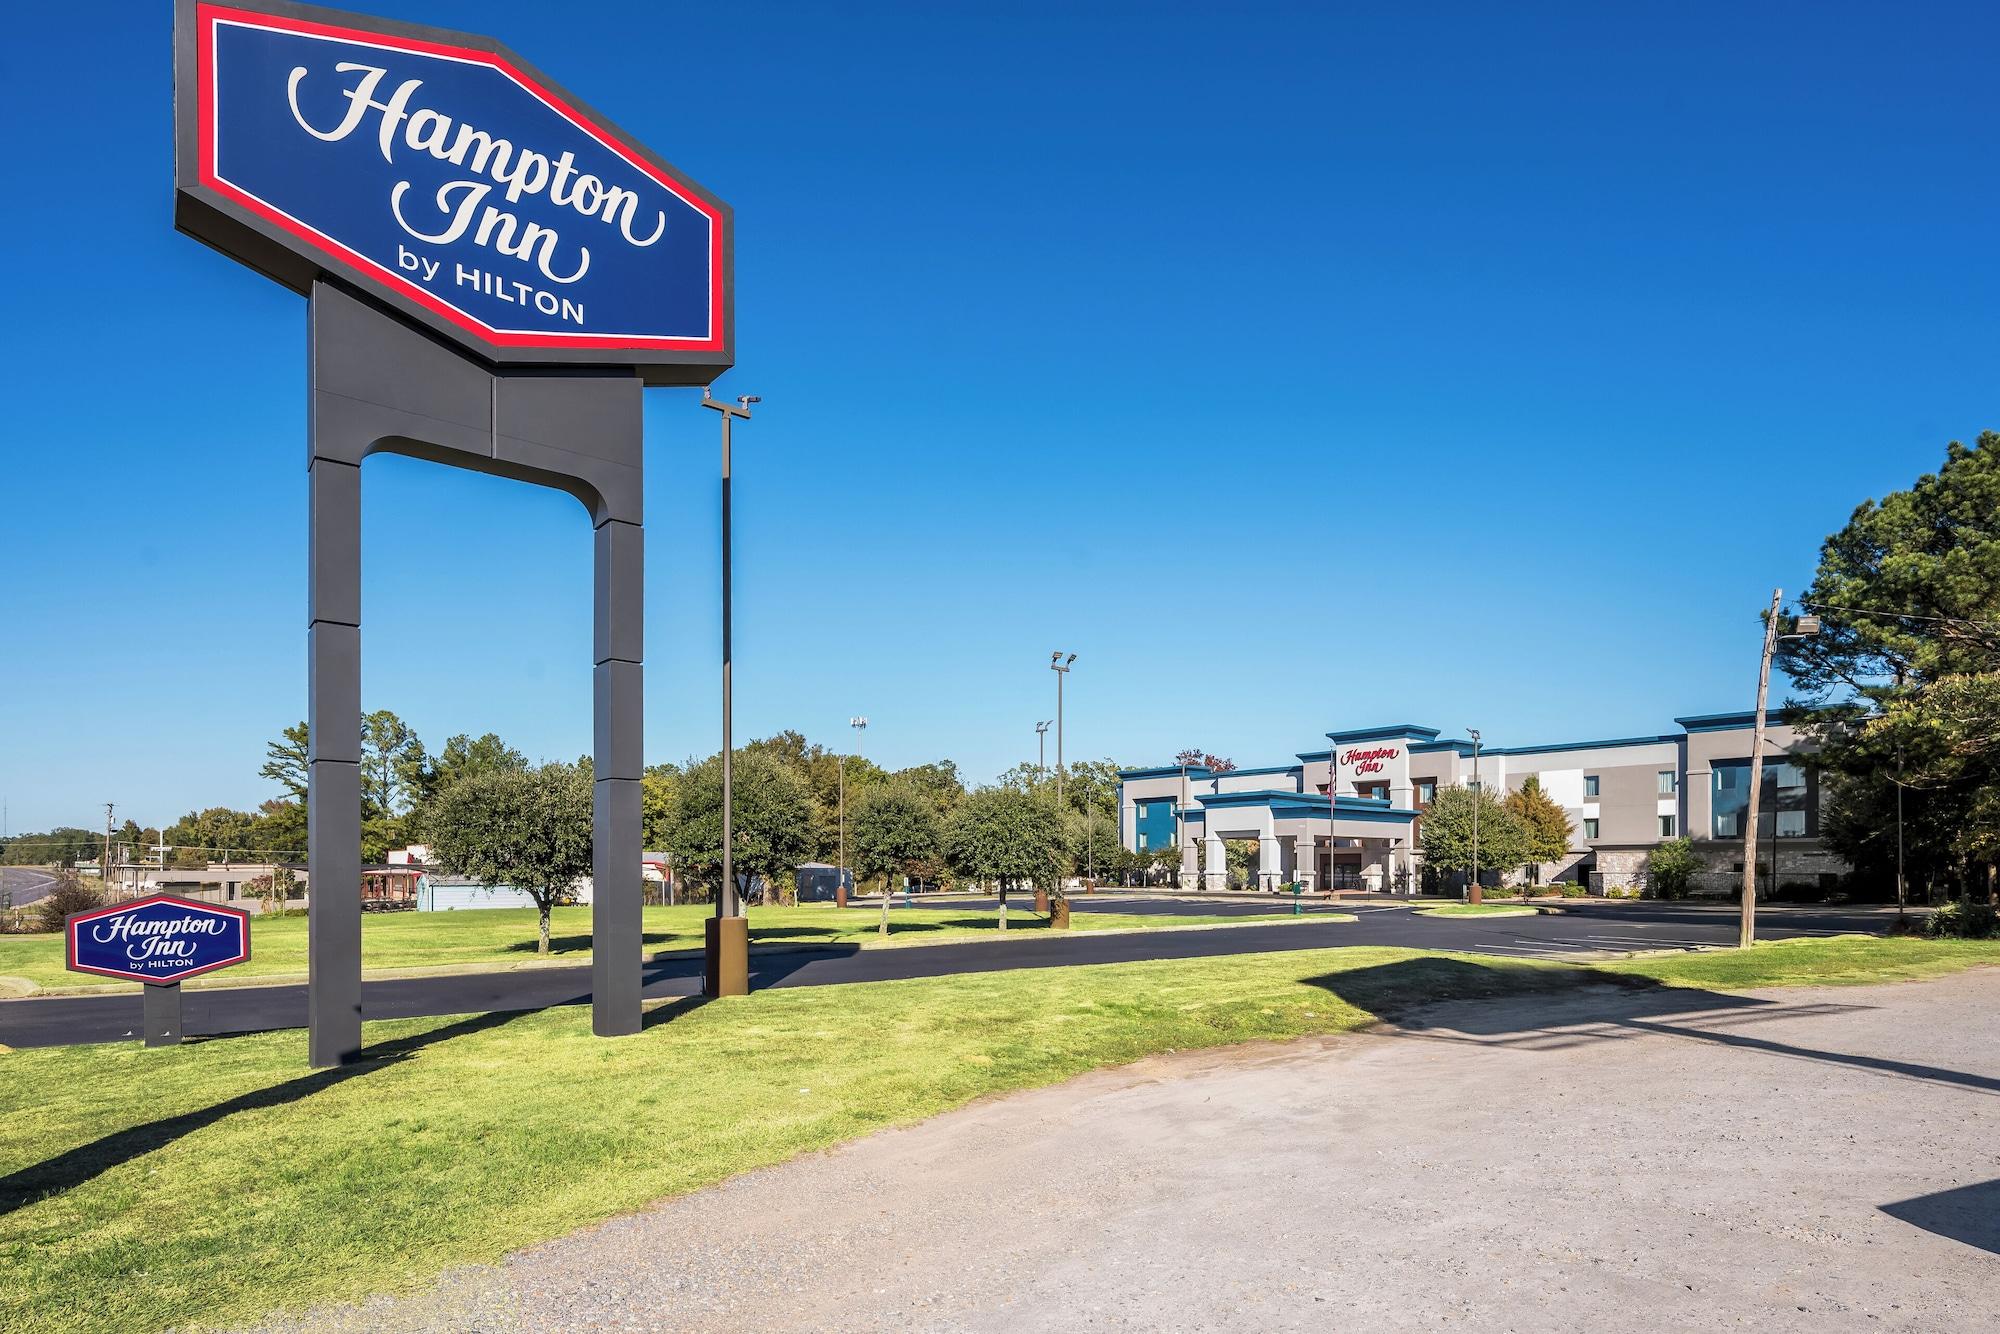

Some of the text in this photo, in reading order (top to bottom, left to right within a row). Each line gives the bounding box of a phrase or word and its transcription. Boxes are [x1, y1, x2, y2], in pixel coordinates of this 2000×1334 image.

[287, 61, 666, 247] Hampton
[391, 180, 591, 284] Inn
[398, 244, 584, 325] by HILTON
[1340, 747, 1399, 765] Hampton
[1355, 761, 1383, 776] Inn
[92, 914, 227, 943] Hampton
[126, 935, 197, 960] Inn
[130, 959, 193, 970] by HILTON
